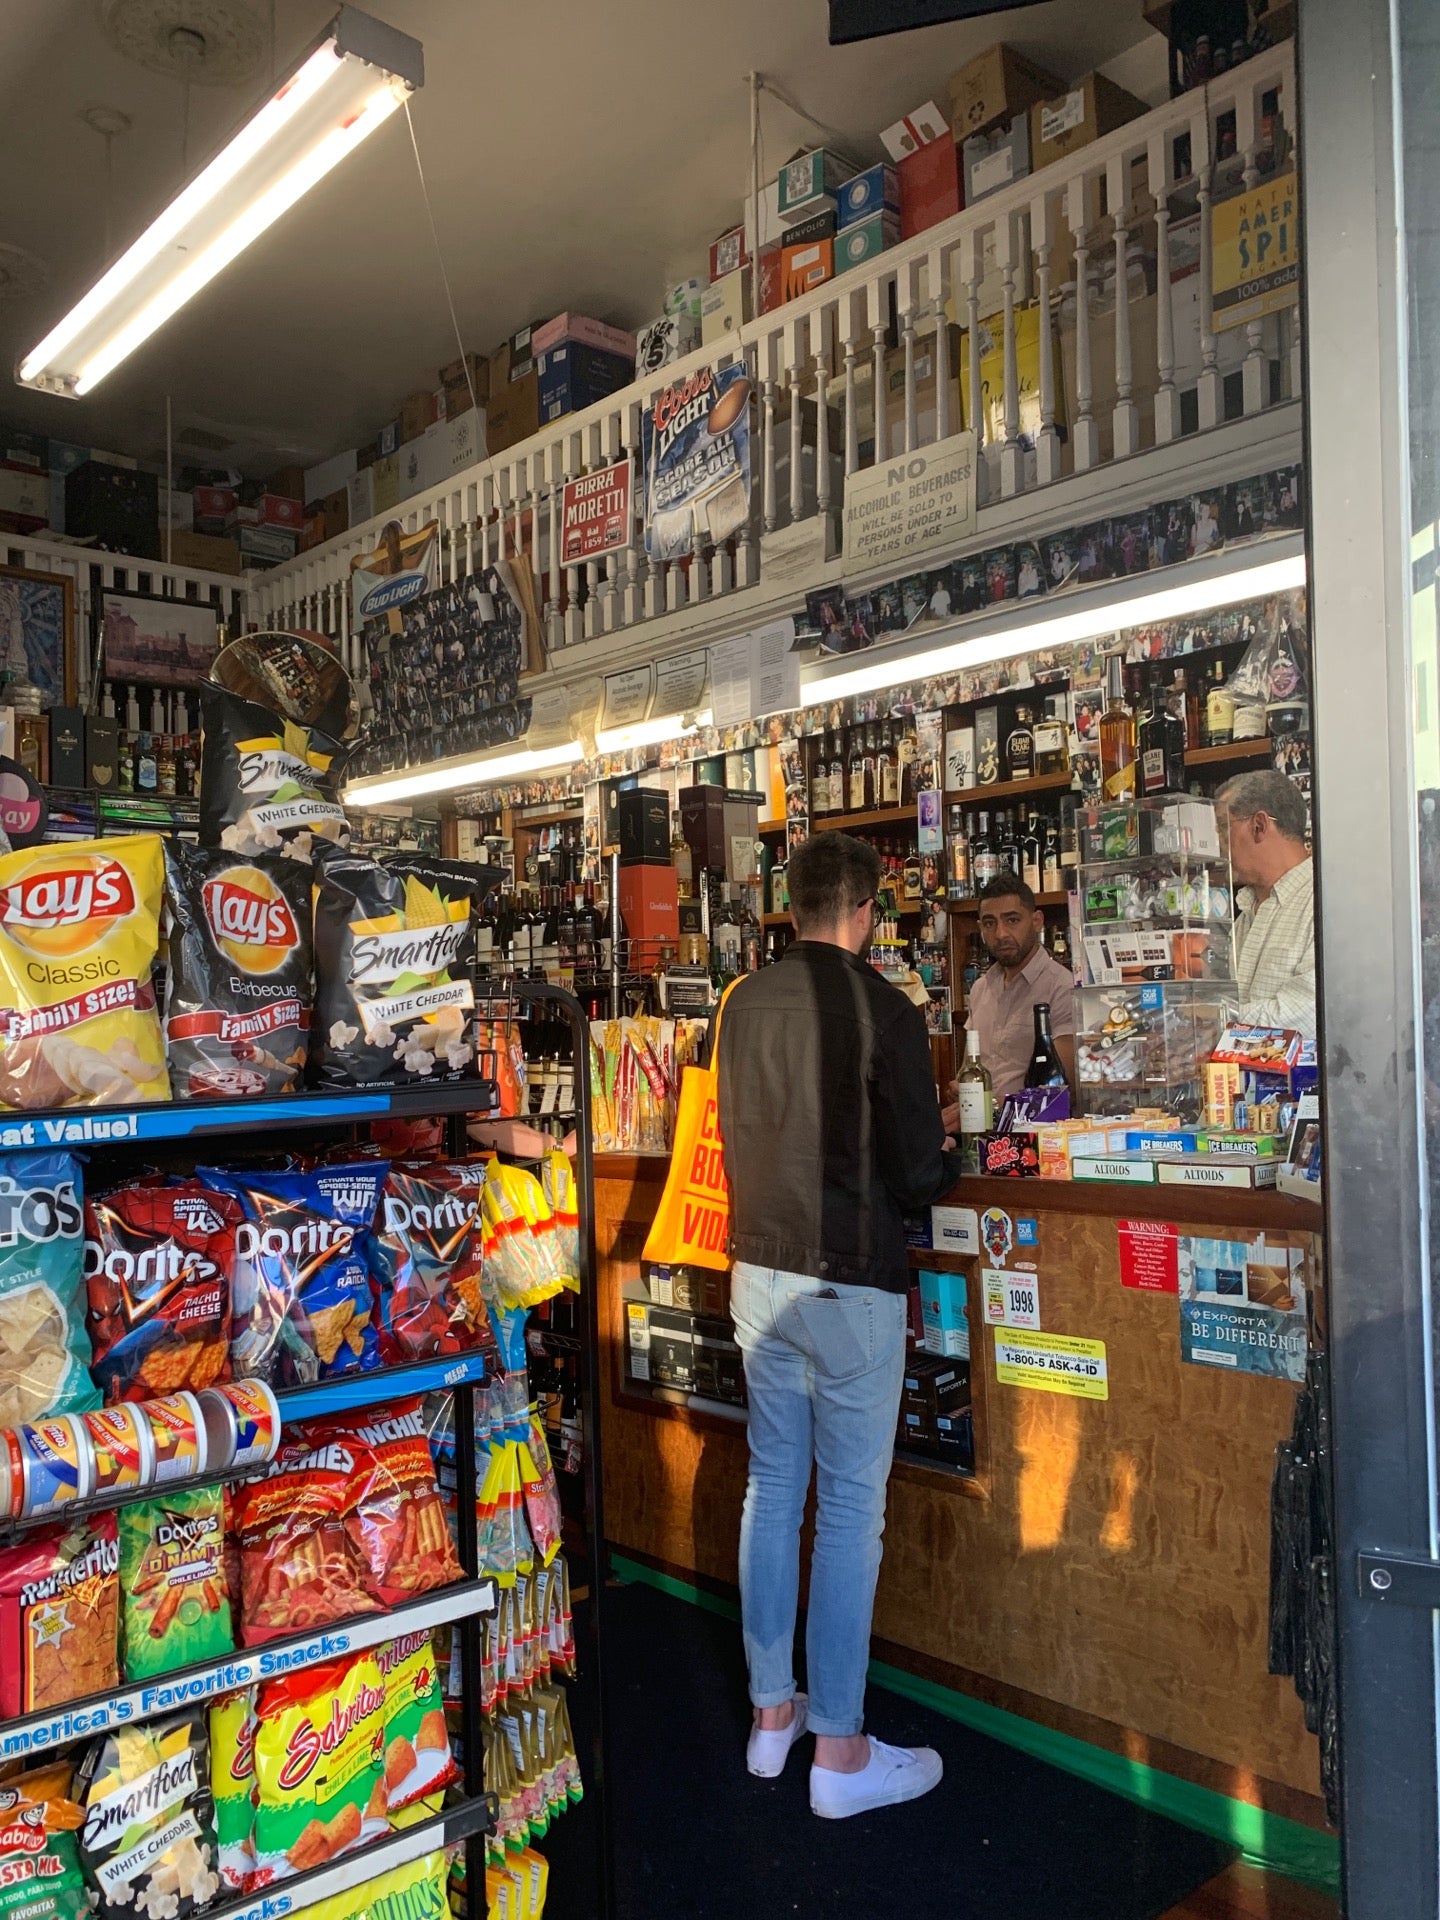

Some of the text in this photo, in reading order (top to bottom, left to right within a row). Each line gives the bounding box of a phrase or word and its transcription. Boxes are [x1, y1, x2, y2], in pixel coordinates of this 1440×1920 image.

[1238, 219, 1298, 269] SPI
[652, 366, 713, 431] Coors
[659, 392, 711, 463] LIGHT
[655, 432, 734, 491] SCORE ALL
[887, 457, 927, 488] NO
[574, 470, 615, 499] BIRRA
[655, 449, 738, 509] SEASON
[847, 463, 972, 523] ALCOHOLIC BEVERAGES
[565, 488, 625, 528] MORETTI
[862, 491, 953, 533] WILL BE SOLD TO
[857, 505, 958, 548] PERSONS UNDER 21
[867, 523, 943, 559] YEARS OF AGE
[365, 577, 424, 613] BUD LIGHT
[0, 804, 31, 830] ay
[257, 806, 297, 823] WHITE
[3, 867, 122, 929] Lay's
[213, 884, 287, 945] Lay's
[26, 956, 121, 985] Classic
[229, 976, 297, 998] Barbecue
[9, 981, 136, 1038] Family Size!
[369, 986, 465, 1020] WHITE CHEDDAR
[221, 1002, 301, 1040] Family Size!
[366, 1080, 396, 1088] ARTIFICIAL
[42, 1114, 138, 1144] Value!
[986, 1146, 1020, 1171] ROCKS
[988, 1136, 1011, 1156] POP
[1140, 1139, 1184, 1152] ICE BREAKERS
[1208, 1141, 1258, 1155] ICE BREAKERS
[317, 1176, 355, 1185] ACTIVATE
[1094, 1164, 1131, 1176] ALTOIDS
[1184, 1168, 1225, 1182] ALTOIDS
[318, 1182, 377, 1191] SPIDEY-SENSE
[332, 1190, 376, 1208] WIN
[1127, 1221, 1170, 1234] WARNING:
[10, 1267, 42, 1285] STYLE
[337, 1274, 366, 1289] RANCH
[178, 1302, 221, 1321] CHEESE
[185, 1290, 220, 1308] NACHO
[1009, 1289, 1035, 1314] 1998
[1202, 1310, 1255, 1327] EXPORT
[1191, 1322, 1301, 1352] BE DIFFERENT
[1005, 1352, 1098, 1376] 1-800-5 ASK-4-ID
[1008, 1346, 1025, 1355] Report
[1033, 1349, 1054, 1358] Unlawful
[1055, 1353, 1077, 1362] Tobacco
[31, 1433, 60, 1462] BEAN DIP
[45, 1424, 68, 1448] Fritos
[101, 1430, 130, 1456] CHEDDAR
[230, 1443, 355, 1496] NCHIES
[158, 1515, 218, 1544] Doritos
[168, 1567, 217, 1587] CHILE LIMÓN
[0, 1634, 350, 1756] merica's Favorite Snacks
[324, 1750, 371, 1797] CHILE LIME
[82, 1747, 196, 1849] Smartfood
[104, 1817, 193, 1881] WHITE CHEDDAR
[0, 1860, 36, 1889] STA
[10, 1898, 56, 1920] FAVORITAS
